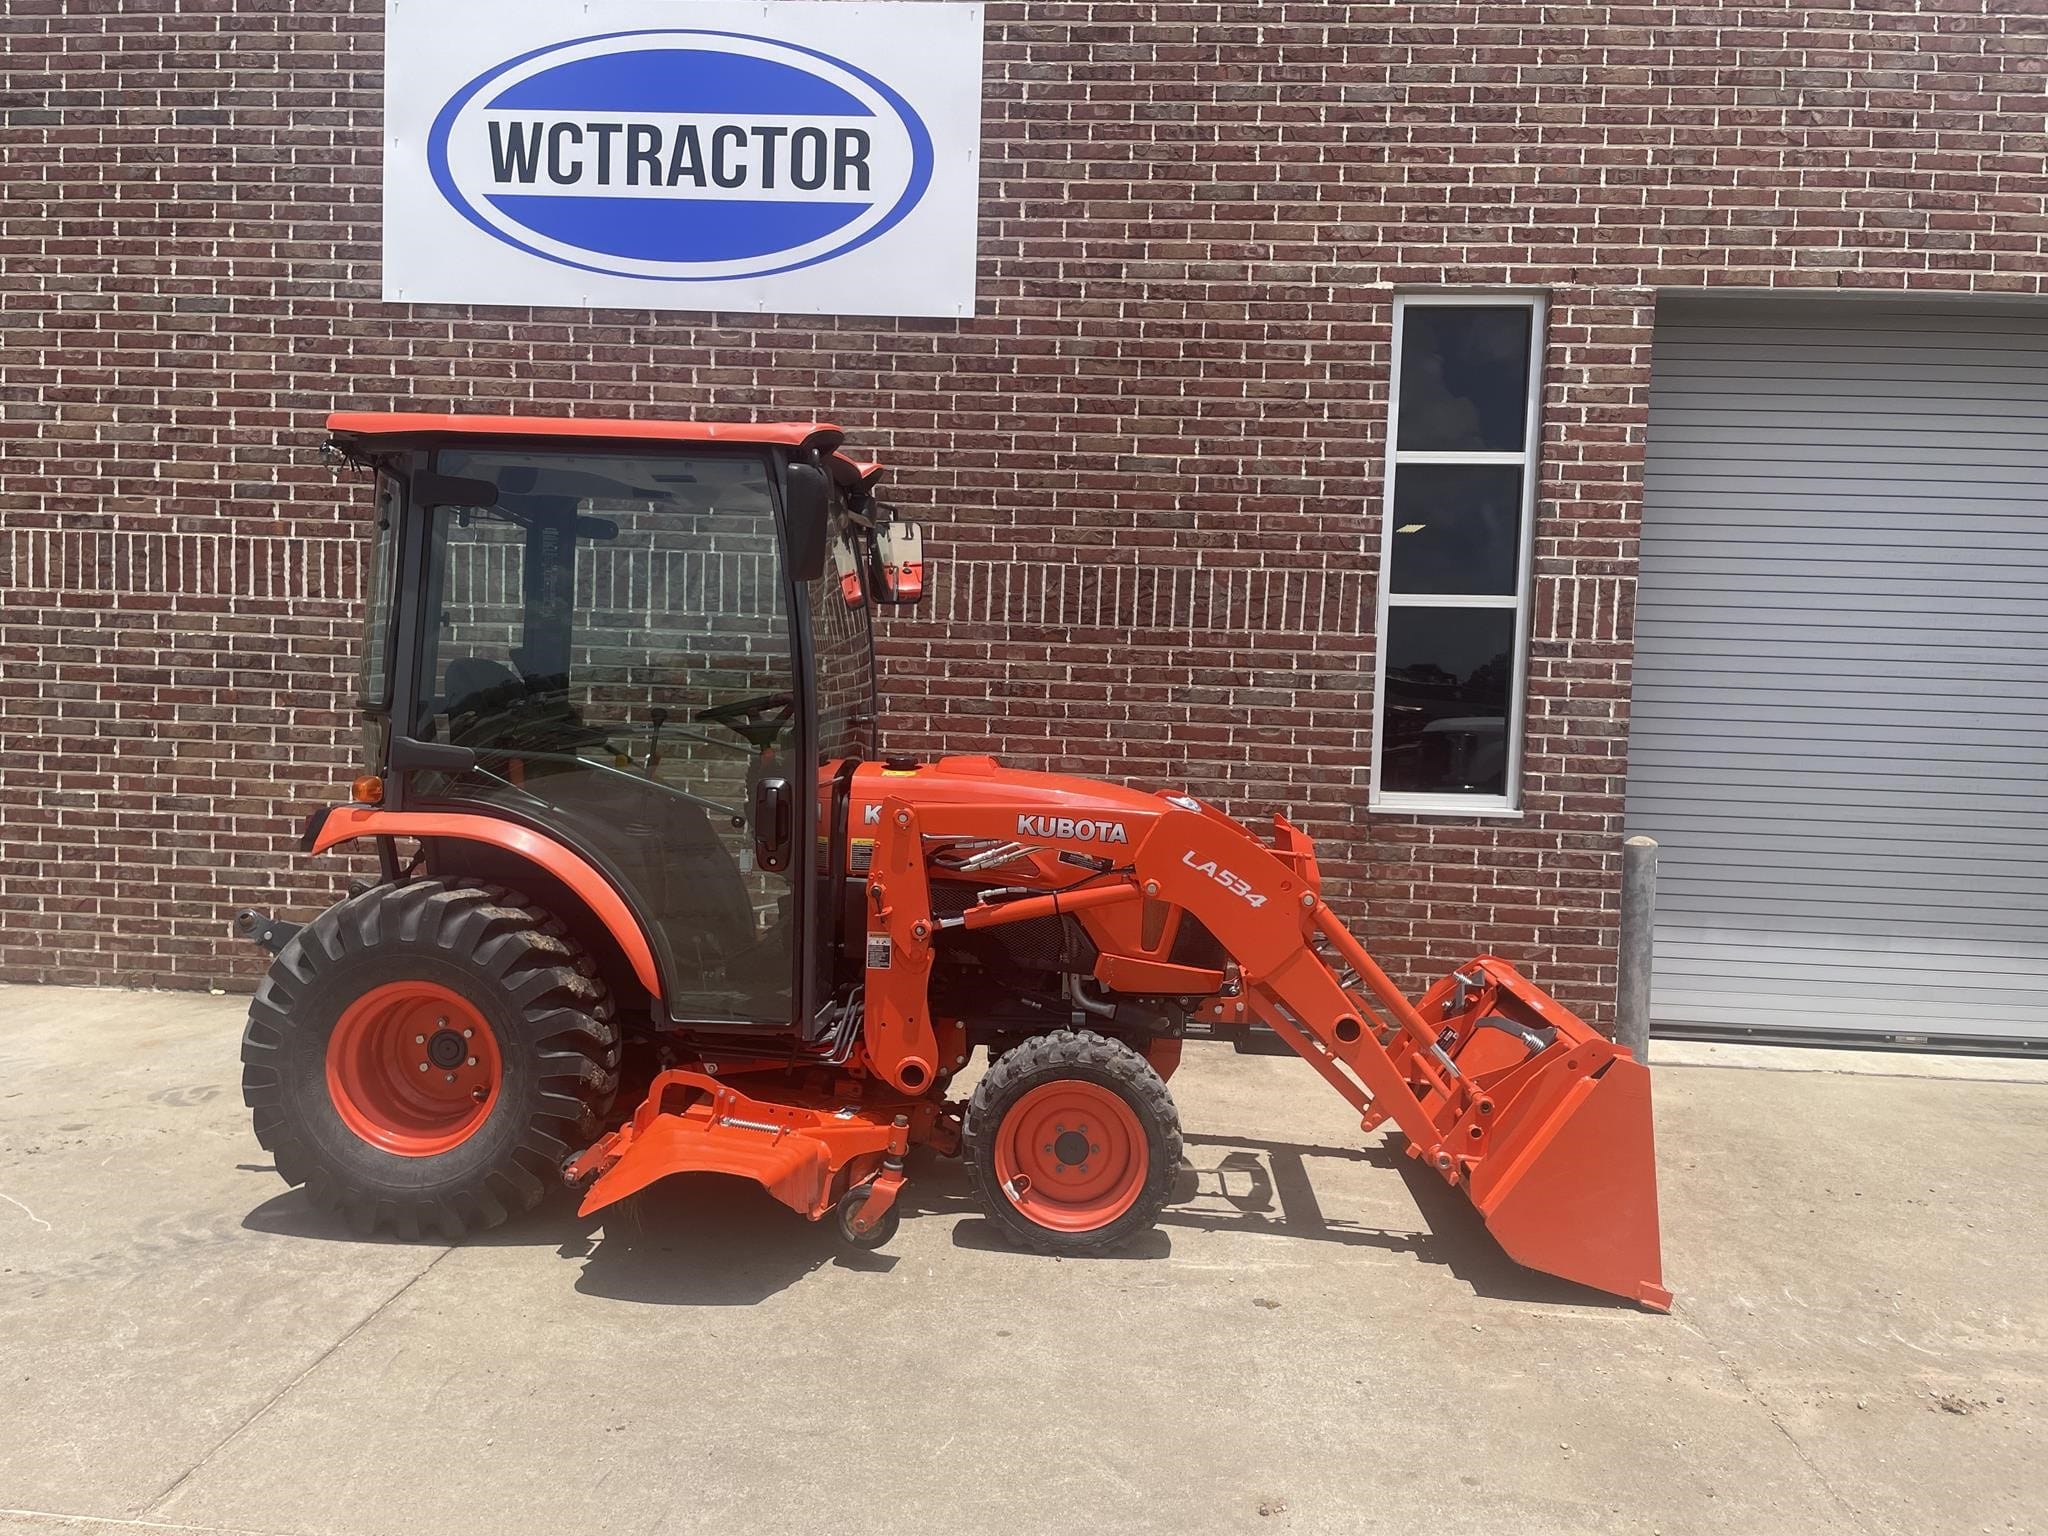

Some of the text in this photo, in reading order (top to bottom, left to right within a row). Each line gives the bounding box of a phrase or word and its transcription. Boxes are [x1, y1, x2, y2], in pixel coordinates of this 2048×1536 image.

[488, 121, 871, 191] WCTRACTOR
[1017, 814, 1128, 843] KUBOTA
[1182, 850, 1268, 907] LA534
